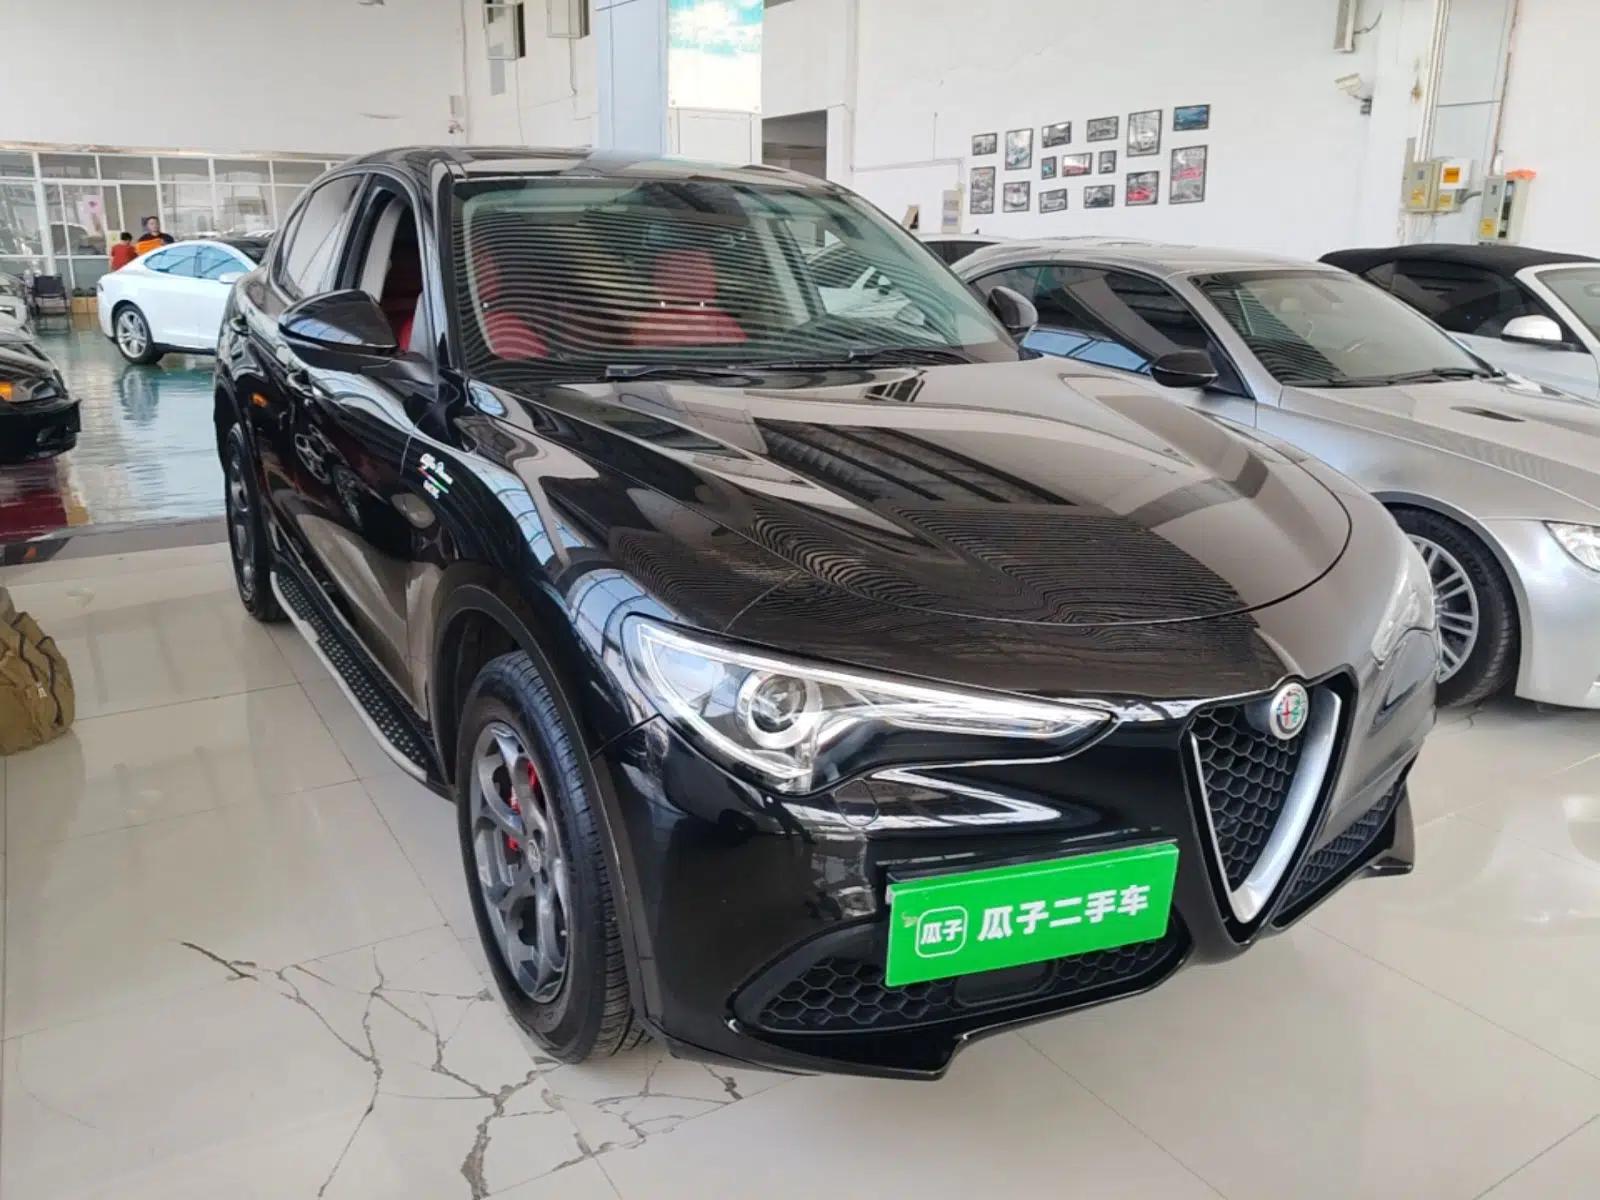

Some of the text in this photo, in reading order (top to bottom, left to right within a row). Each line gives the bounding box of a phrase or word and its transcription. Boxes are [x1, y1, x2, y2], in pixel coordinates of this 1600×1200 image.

[920, 920, 963, 945] 瓜子
[977, 885, 1150, 942] 瓜子二手车
